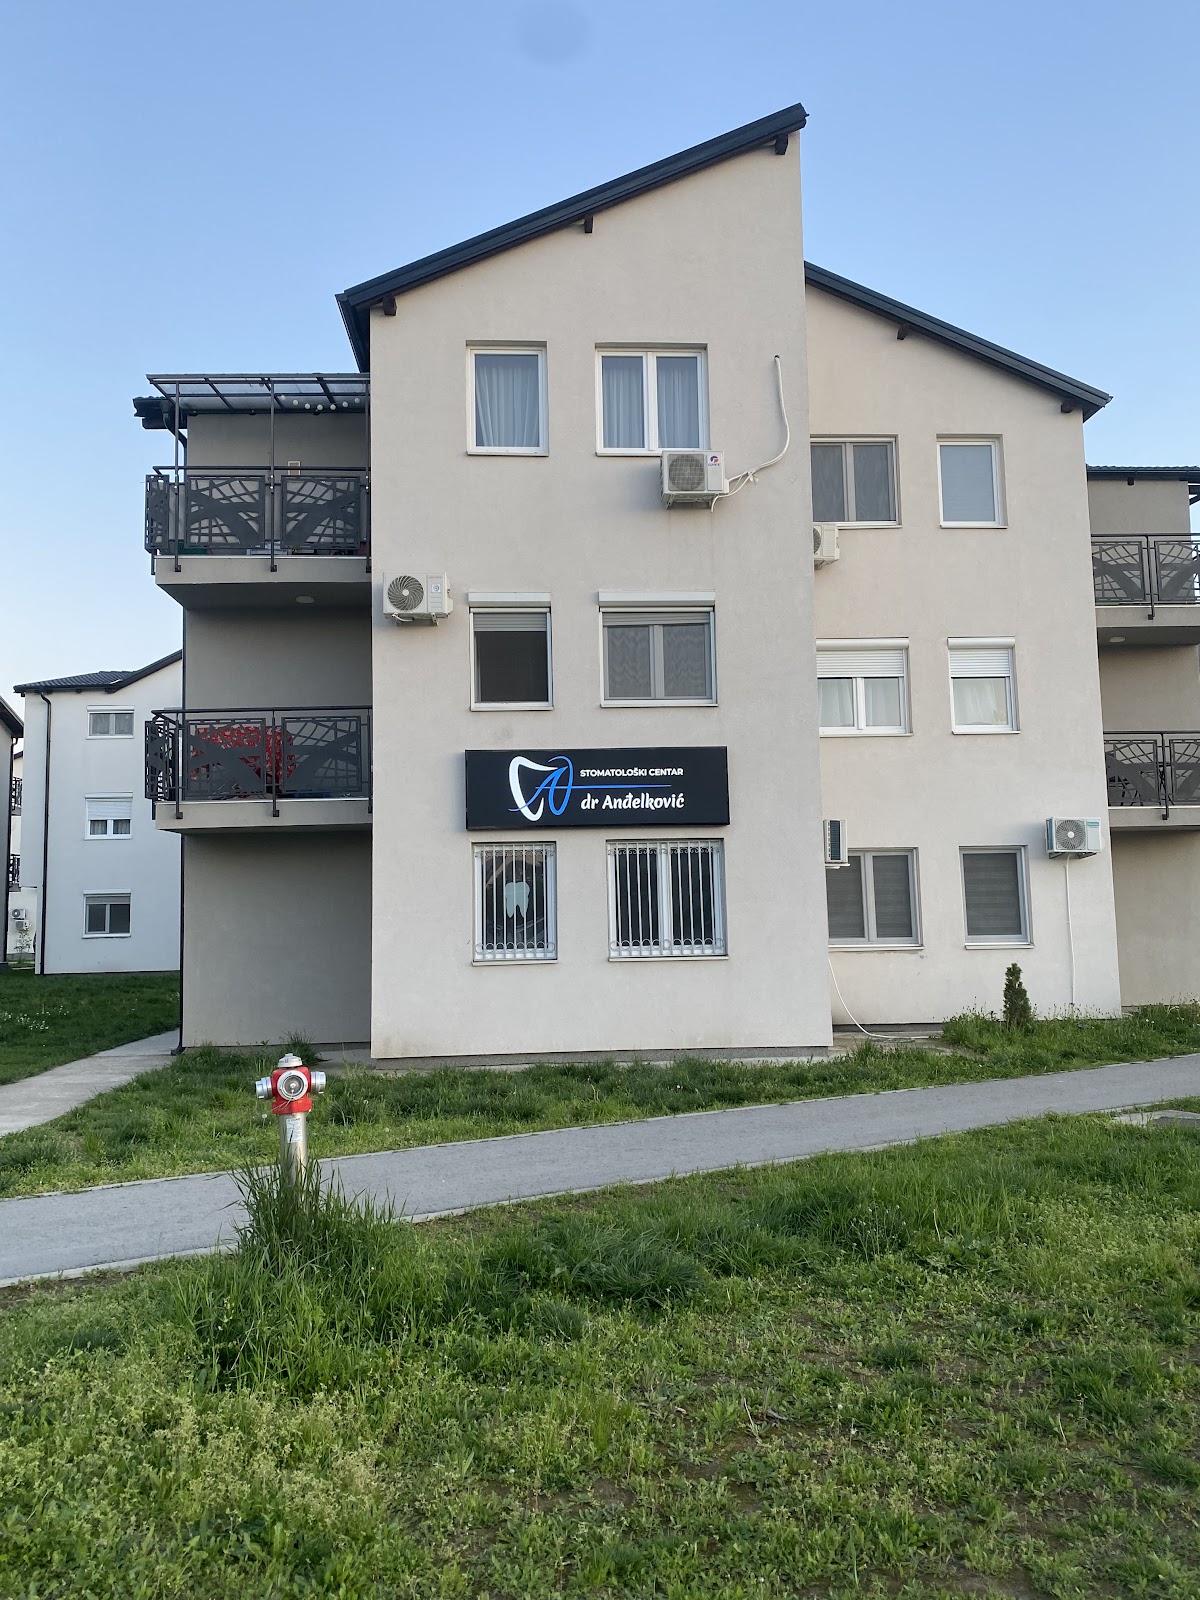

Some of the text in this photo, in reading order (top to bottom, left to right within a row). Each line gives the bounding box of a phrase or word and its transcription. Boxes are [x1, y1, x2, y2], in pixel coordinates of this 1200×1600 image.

[580, 767, 684, 777] STOMATOLOŠKI CENTAR
[580, 792, 685, 811] dr Anđelković
